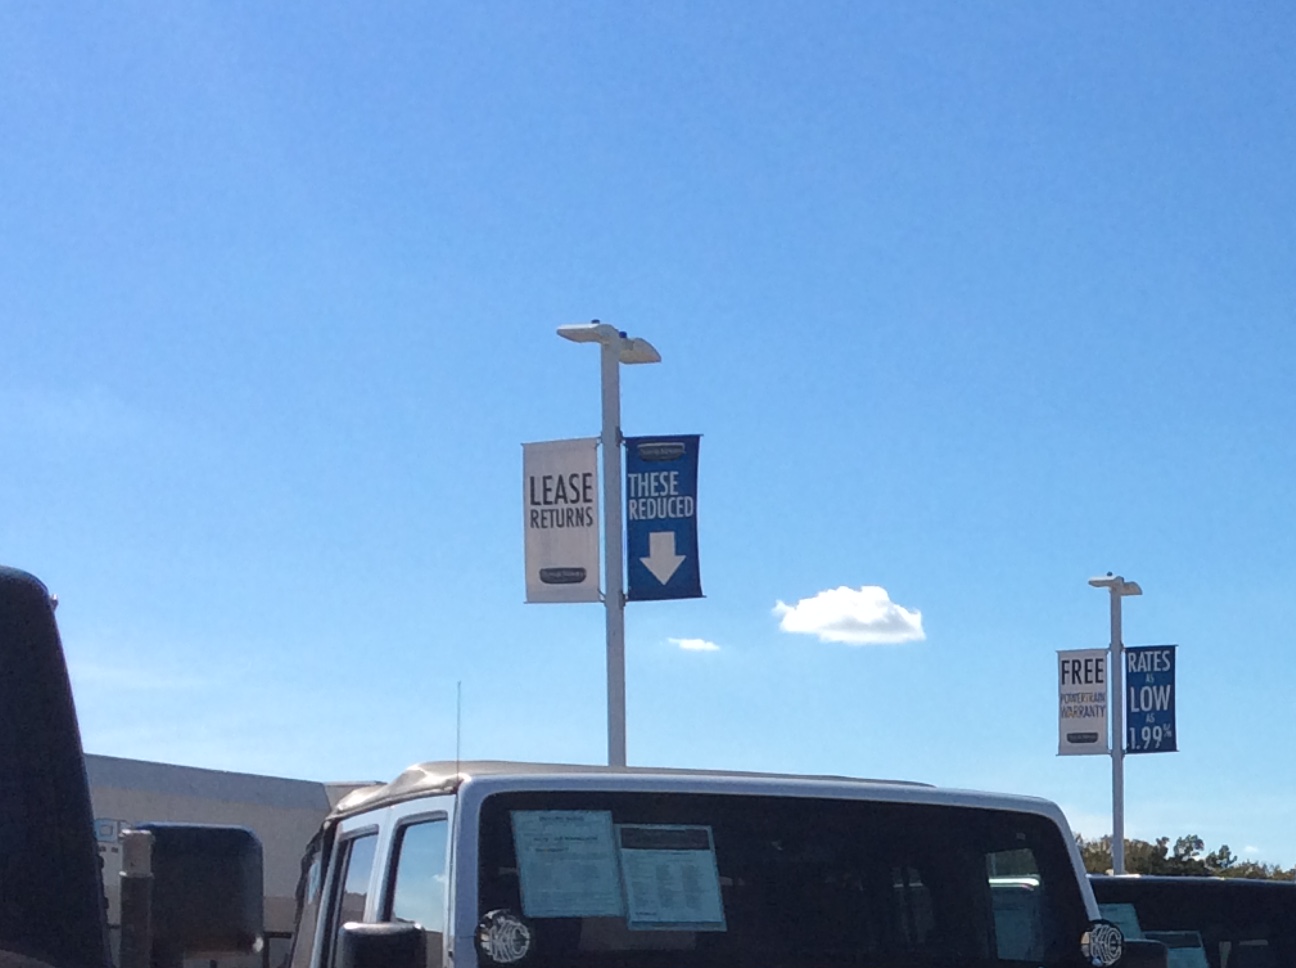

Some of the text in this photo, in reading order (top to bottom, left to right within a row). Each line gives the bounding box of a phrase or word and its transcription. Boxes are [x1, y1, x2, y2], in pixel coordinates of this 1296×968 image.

[529, 472, 593, 506] LEASE
[628, 471, 679, 497] THESE
[530, 506, 594, 529] RETURNS
[629, 496, 694, 520] REDUCED
[1061, 658, 1104, 686] FREE
[1127, 650, 1171, 673] RATES
[1130, 685, 1171, 713] LOW
